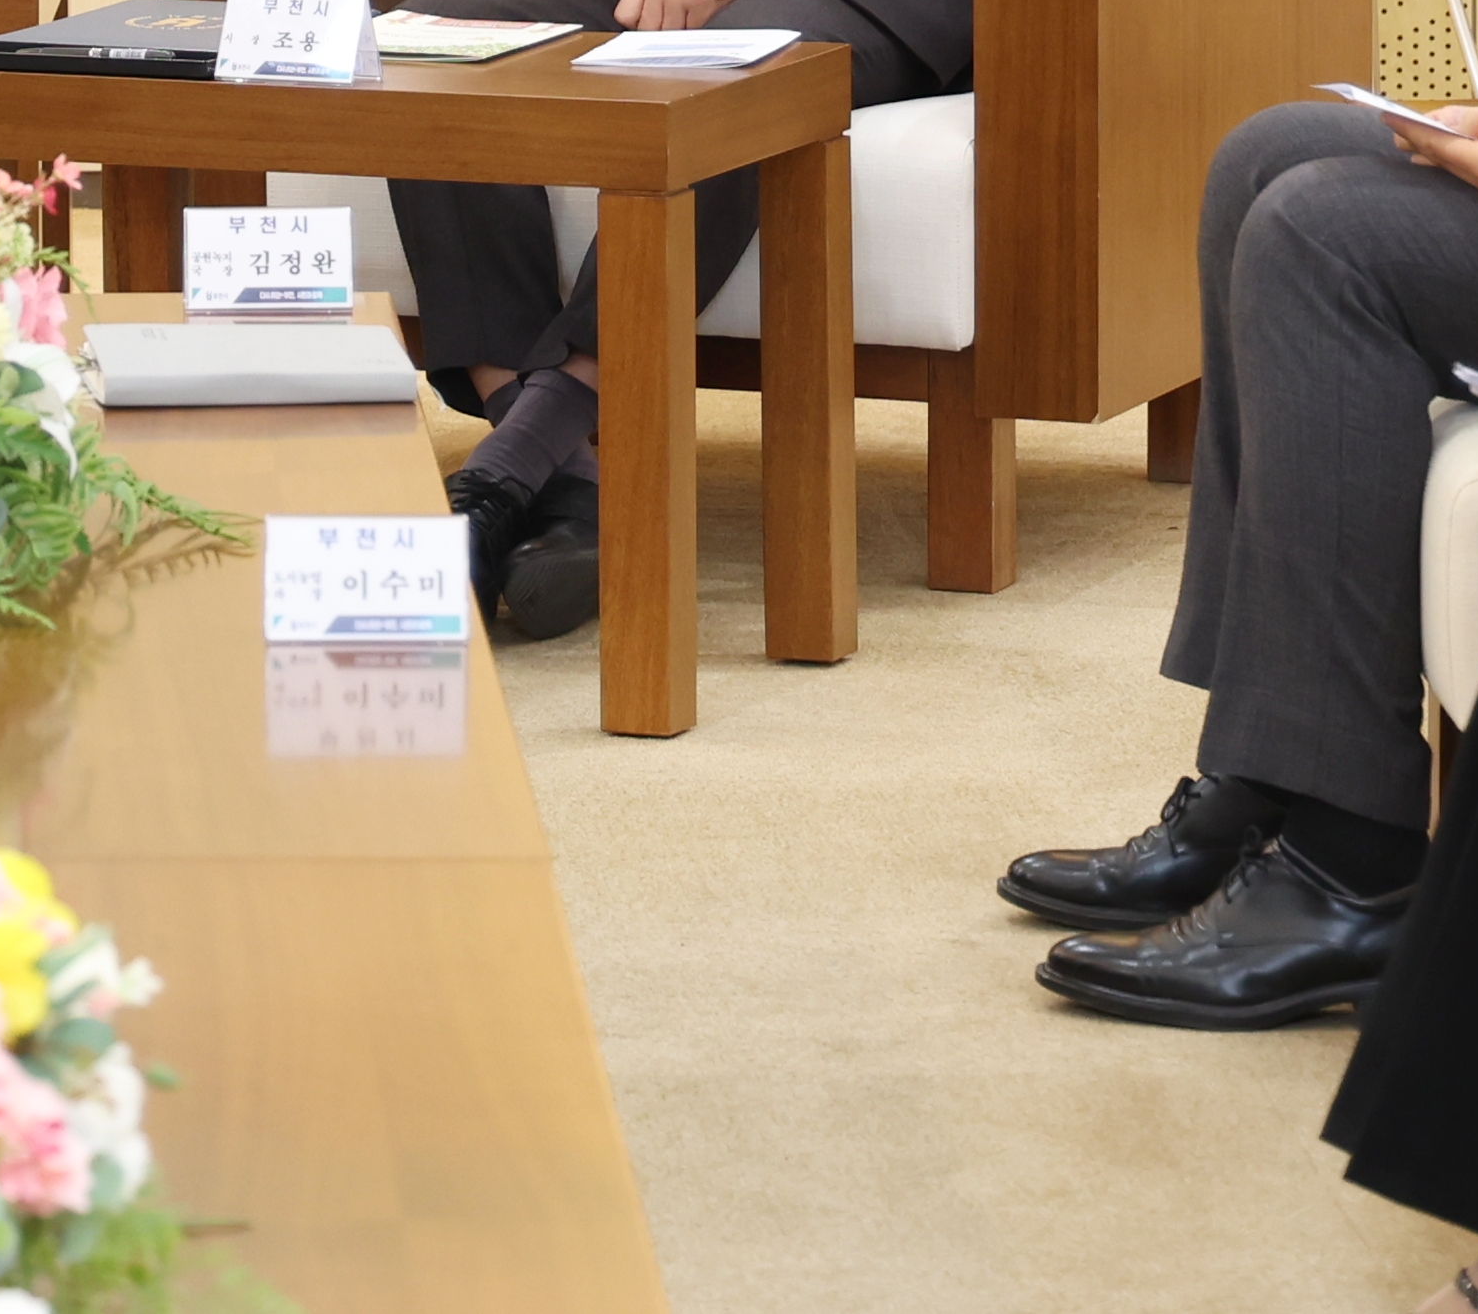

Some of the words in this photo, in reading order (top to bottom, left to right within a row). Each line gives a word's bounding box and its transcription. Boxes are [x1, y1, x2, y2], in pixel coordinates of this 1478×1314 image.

[271, 30, 328, 53] 조용
[228, 215, 310, 235] 부천시
[249, 249, 337, 276] 김정완
[318, 526, 416, 550] 부천시
[342, 569, 445, 601] 이수미
